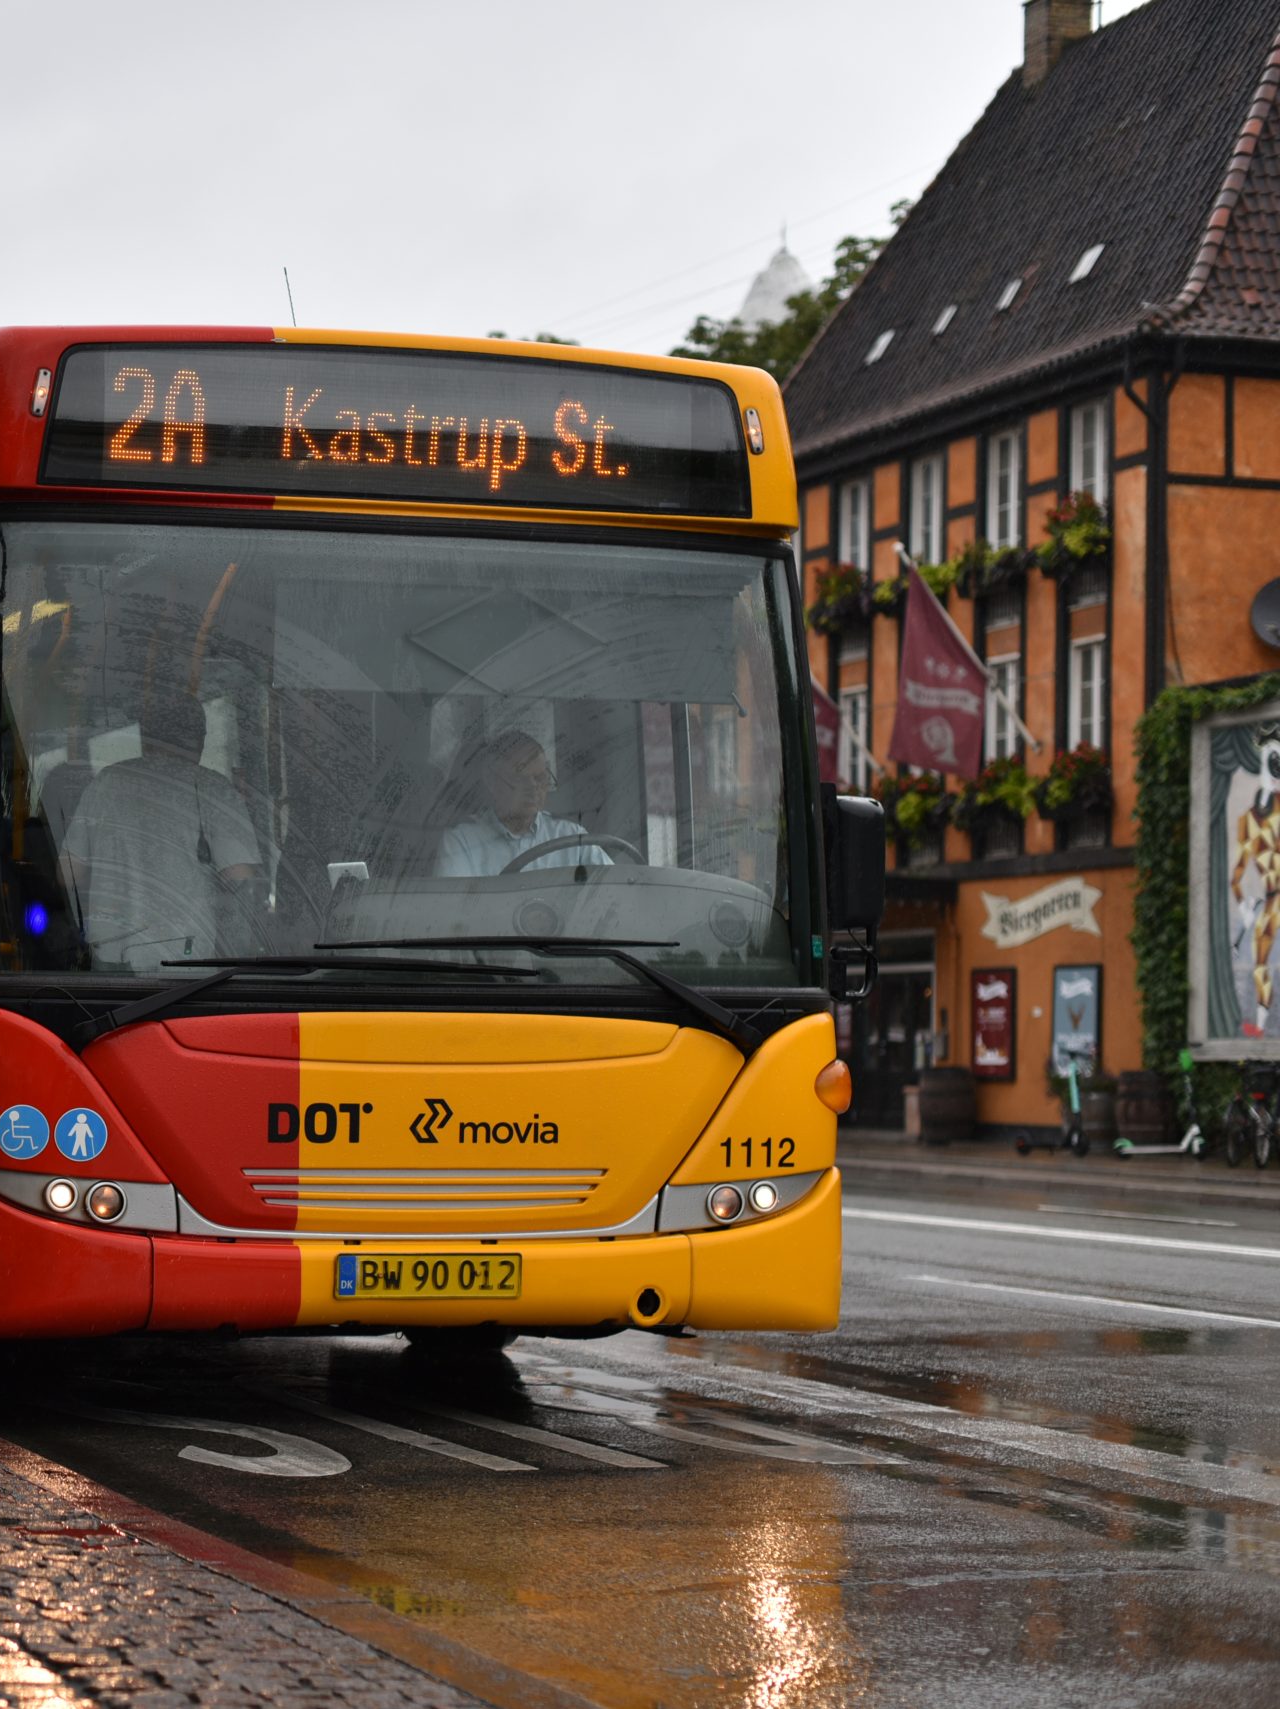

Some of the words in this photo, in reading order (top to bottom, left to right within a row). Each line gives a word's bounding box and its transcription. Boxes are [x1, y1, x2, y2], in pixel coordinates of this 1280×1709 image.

[110, 366, 206, 463] 2A
[281, 385, 528, 492] Kastrup
[551, 398, 629, 476] St.
[267, 1102, 372, 1144] DOT
[458, 1113, 559, 1144] movia
[720, 1136, 796, 1168] 1112
[340, 1279, 353, 1290] DK
[361, 1259, 404, 1291] BW
[412, 1259, 450, 1292] 90
[458, 1259, 516, 1291] 012
